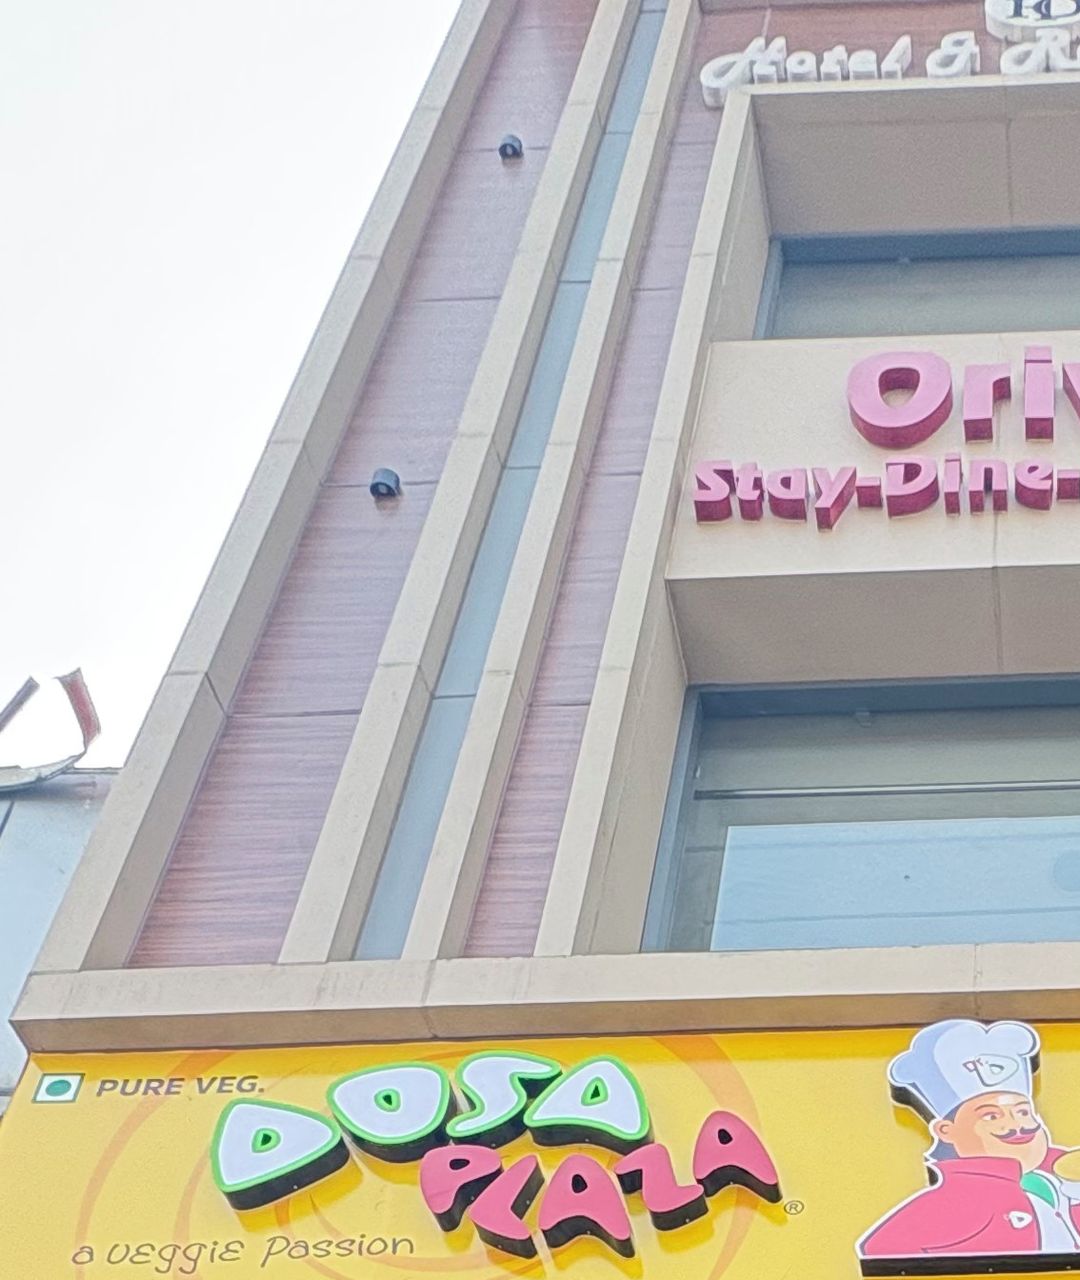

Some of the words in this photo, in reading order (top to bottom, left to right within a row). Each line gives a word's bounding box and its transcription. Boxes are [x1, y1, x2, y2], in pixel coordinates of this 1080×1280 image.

[700, 34, 912, 107] Hotel
[925, 31, 981, 78] &
[96, 1077, 186, 1097] PURE
[194, 1074, 266, 1095] VEG.
[211, 1050, 653, 1211] DOSA
[418, 1109, 784, 1260] PLAZA
[260, 1233, 416, 1269] Passion
